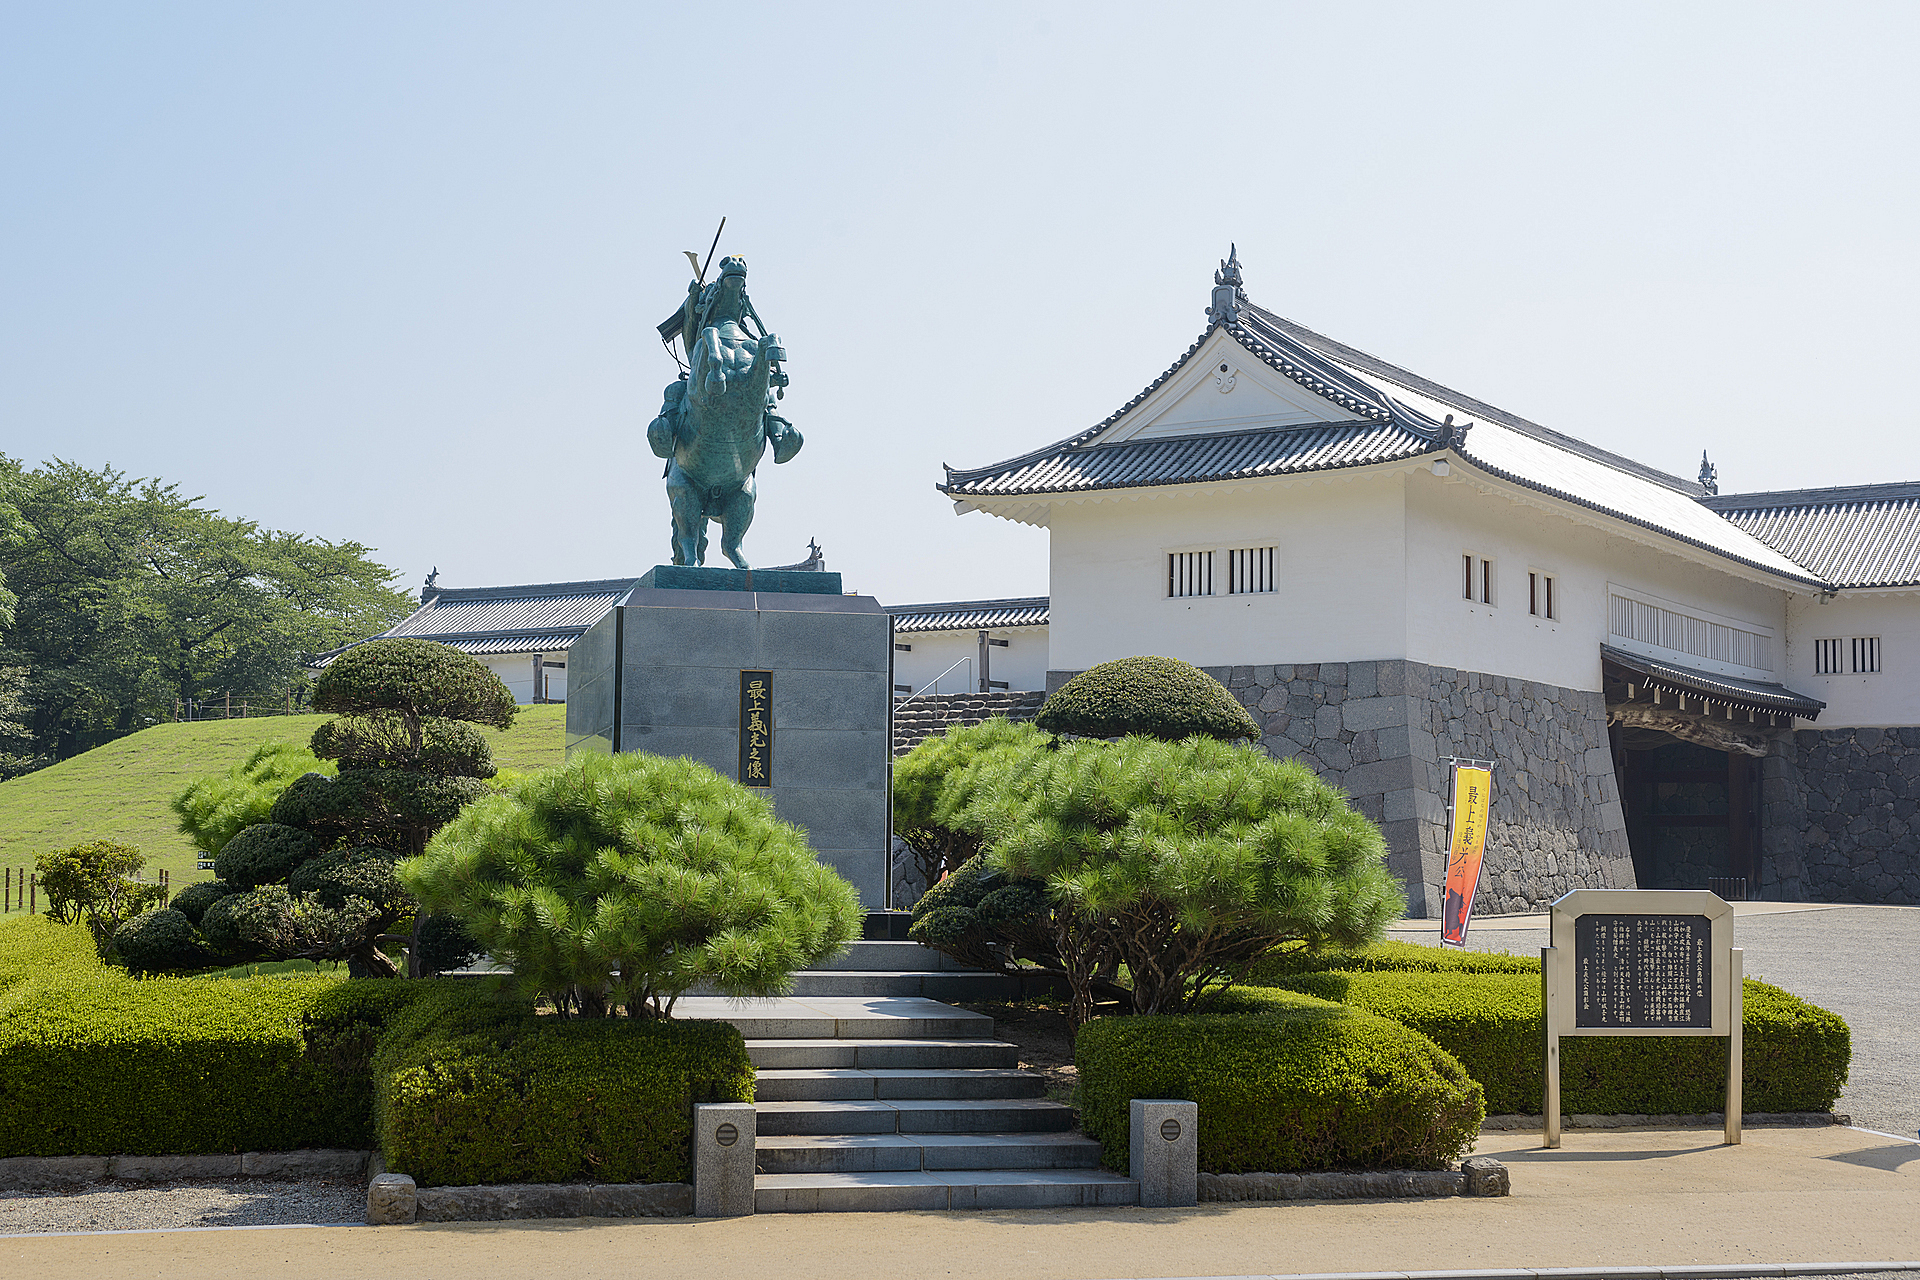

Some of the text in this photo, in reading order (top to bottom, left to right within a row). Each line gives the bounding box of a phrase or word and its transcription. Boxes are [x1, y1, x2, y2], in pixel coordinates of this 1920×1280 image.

[747, 680, 768, 779] 最上義光之像
[1450, 786, 1479, 878] 最上義光公
